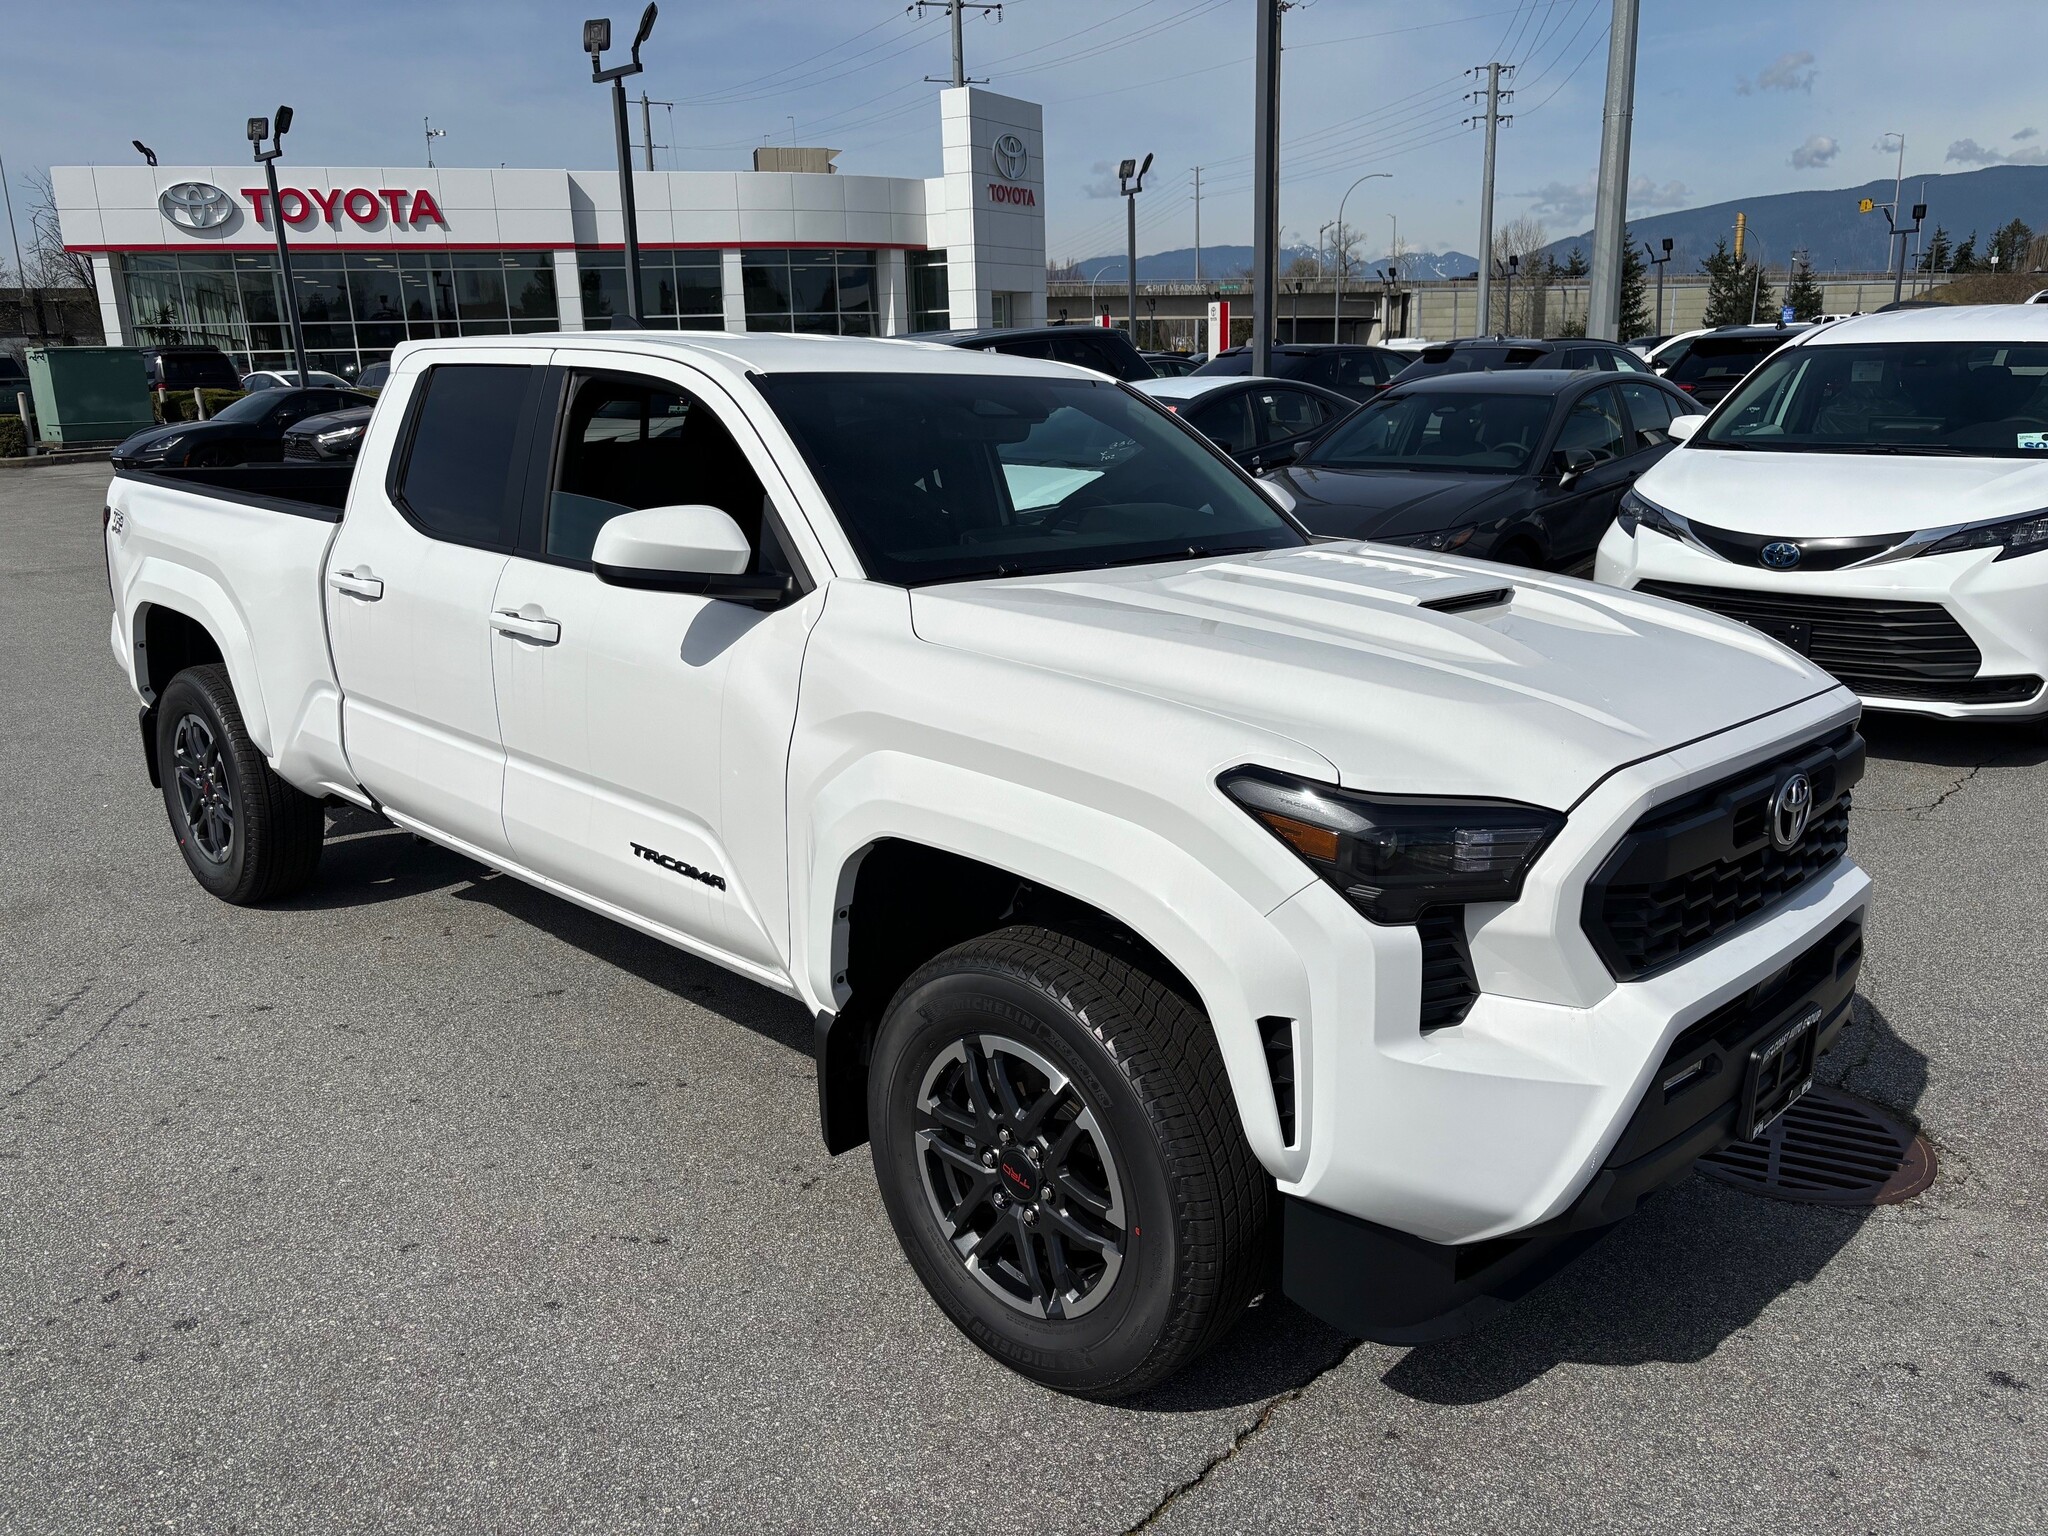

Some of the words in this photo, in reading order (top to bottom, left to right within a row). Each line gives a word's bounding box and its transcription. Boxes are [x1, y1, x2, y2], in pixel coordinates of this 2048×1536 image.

[241, 187, 444, 224] TOYOTA
[988, 183, 1036, 207] TOYOTA
[1152, 284, 1167, 292] PITT
[1169, 284, 1207, 292] MEADOWS
[629, 841, 726, 892] TACOMA
[951, 998, 1035, 1030] MICHELIN
[1002, 1163, 1030, 1190] TRD
[971, 1320, 1057, 1369] MICHELIN
